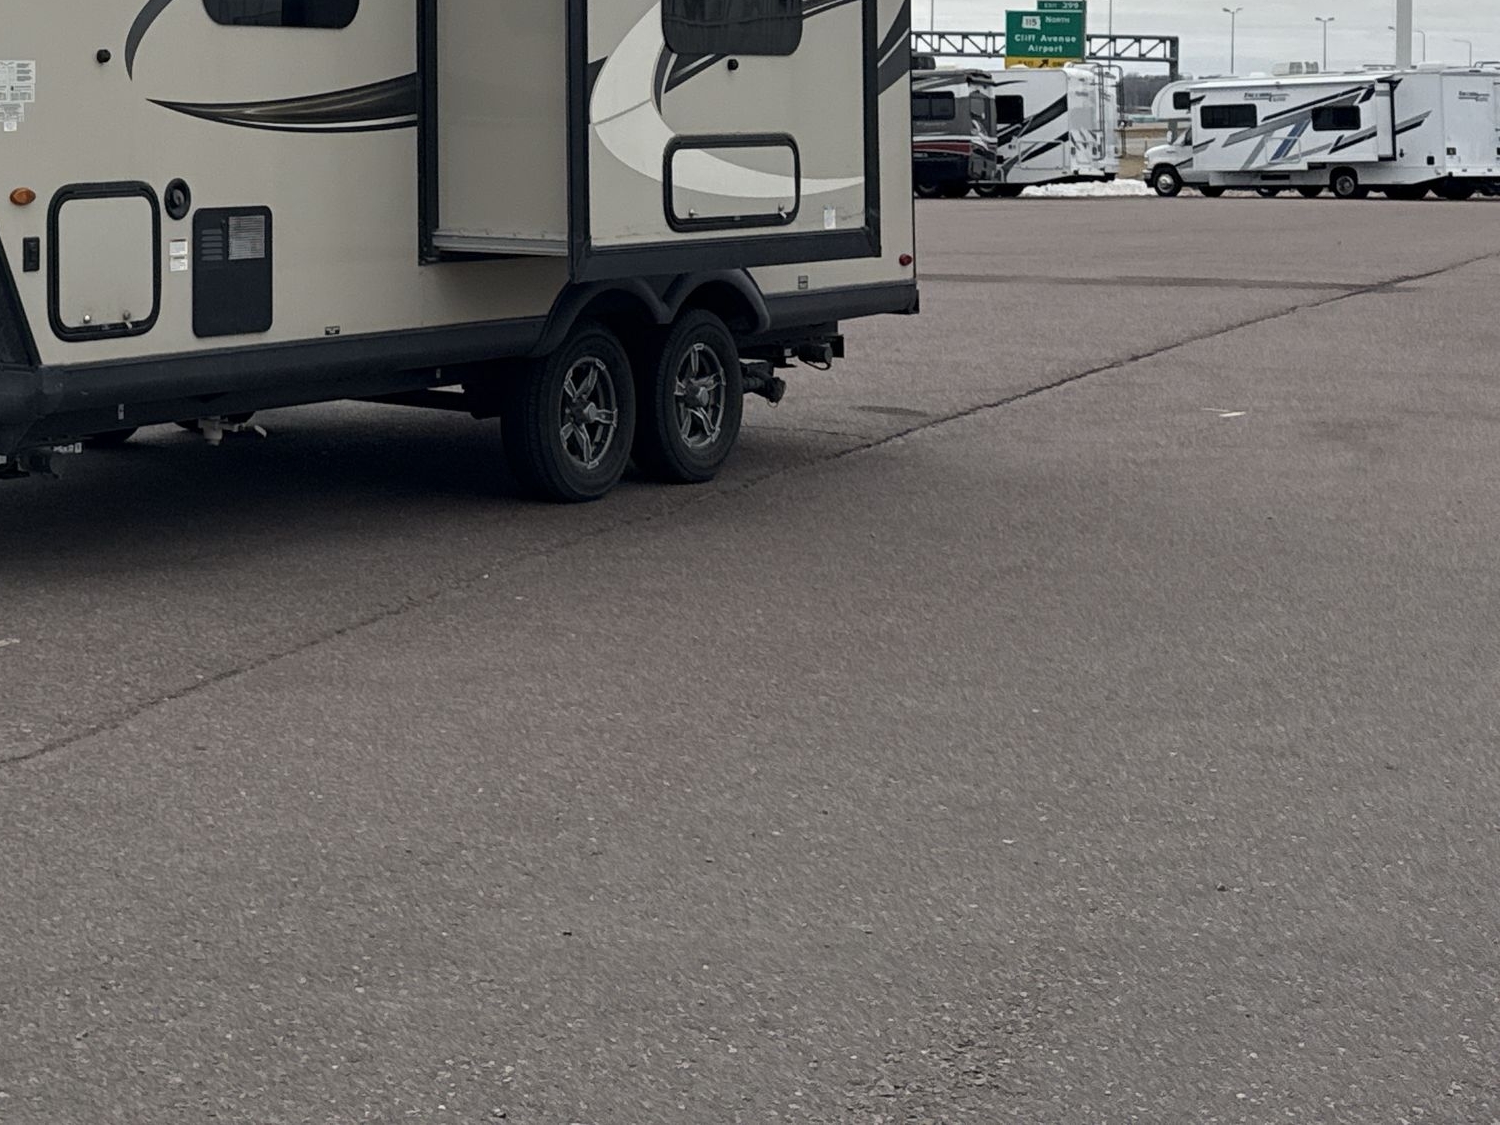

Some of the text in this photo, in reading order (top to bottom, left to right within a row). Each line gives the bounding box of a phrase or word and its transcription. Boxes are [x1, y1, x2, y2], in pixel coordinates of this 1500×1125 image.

[1025, 18, 1037, 26] 115
[1014, 34, 1077, 43] Cliff Avenue
[1027, 44, 1062, 53] Airport
